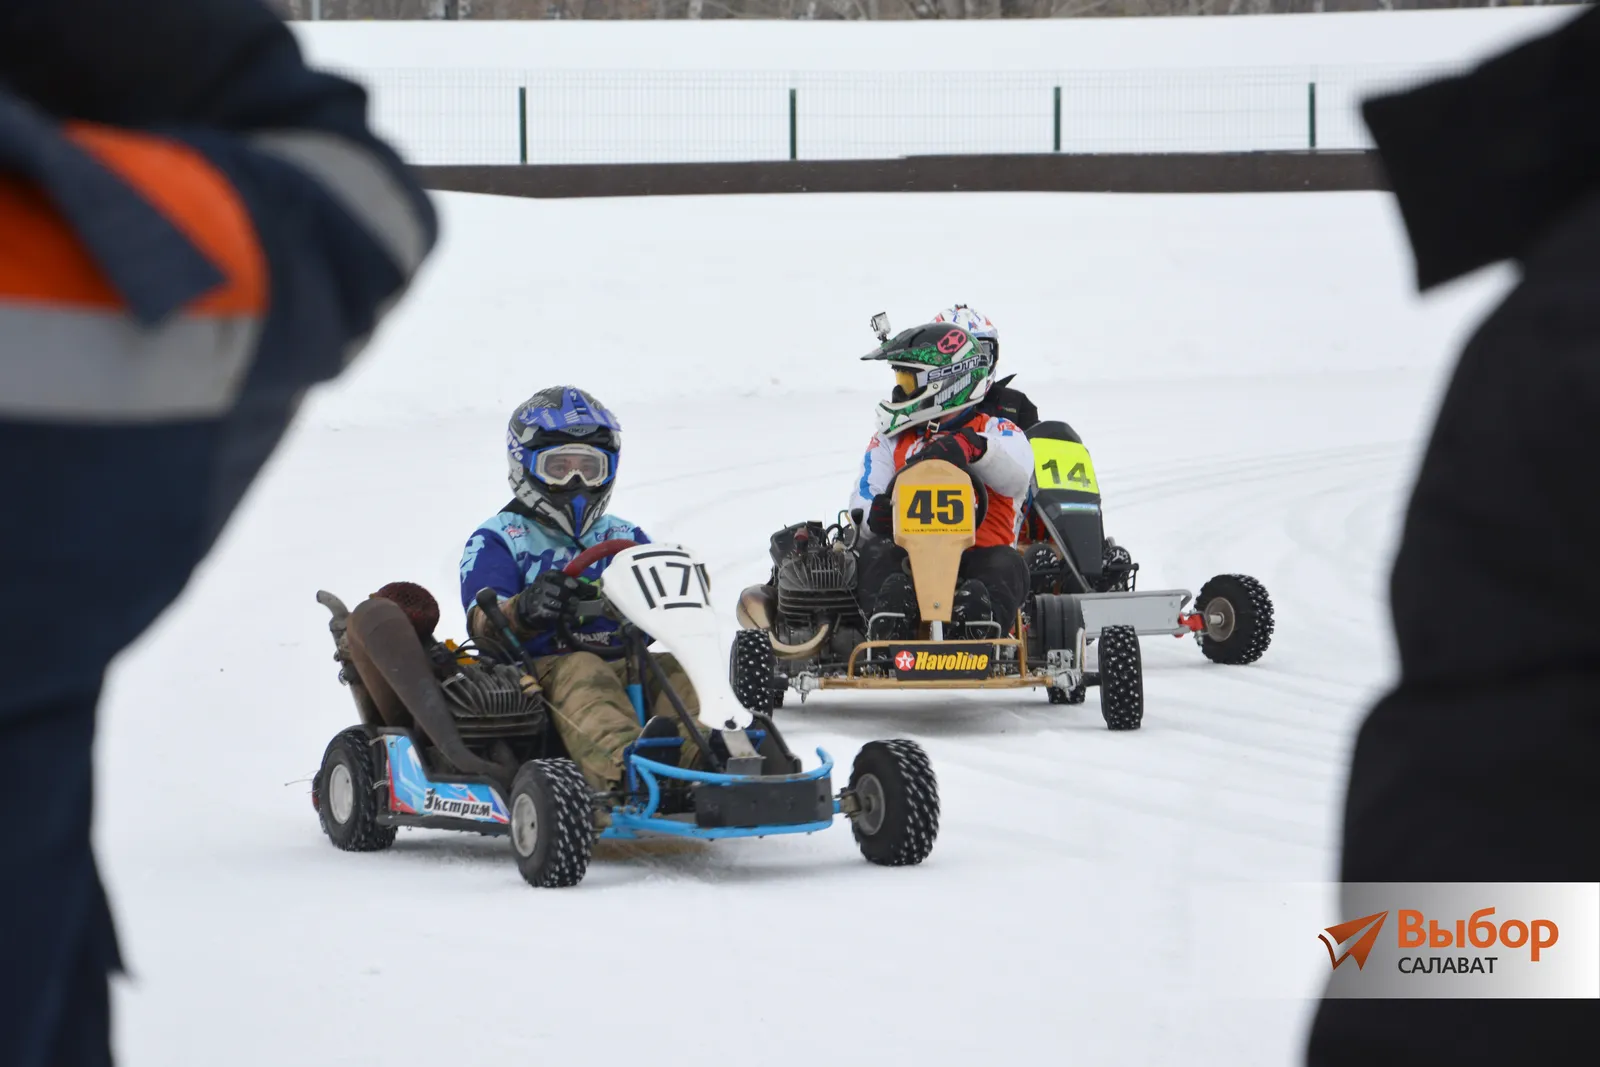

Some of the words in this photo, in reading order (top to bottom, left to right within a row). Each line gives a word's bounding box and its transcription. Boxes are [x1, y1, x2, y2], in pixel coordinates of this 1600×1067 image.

[928, 354, 980, 380] SCOTT
[1041, 458, 1092, 488] 14
[906, 489, 965, 525] 45
[914, 651, 989, 671] Havoline
[424, 787, 491, 816] Экстрим
